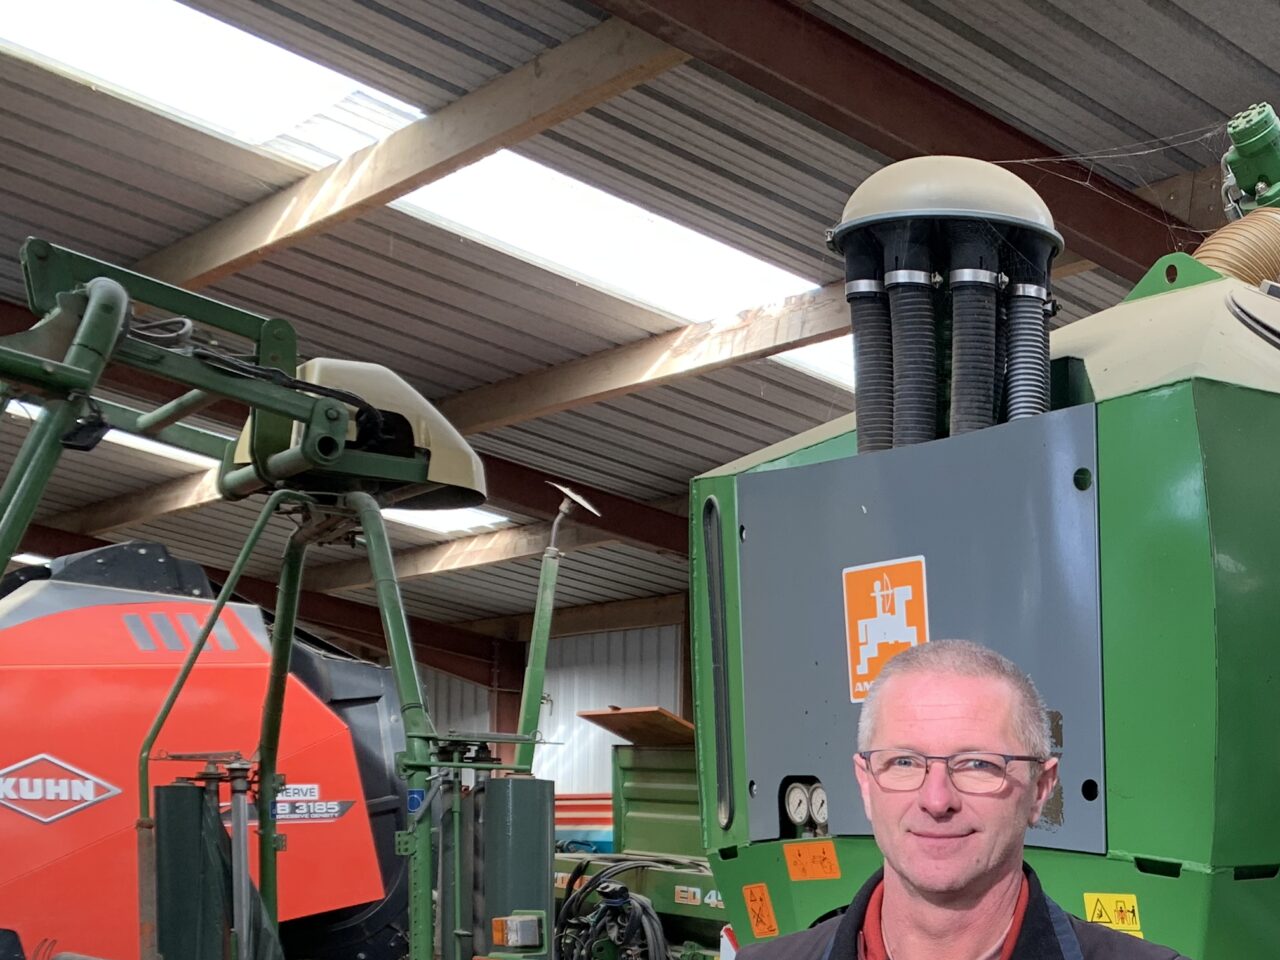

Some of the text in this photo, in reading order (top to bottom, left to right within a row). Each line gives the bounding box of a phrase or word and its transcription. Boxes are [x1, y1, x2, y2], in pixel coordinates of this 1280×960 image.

[0, 777, 94, 800] KUHN
[295, 801, 339, 814] 3185
[674, 885, 701, 905] ED
